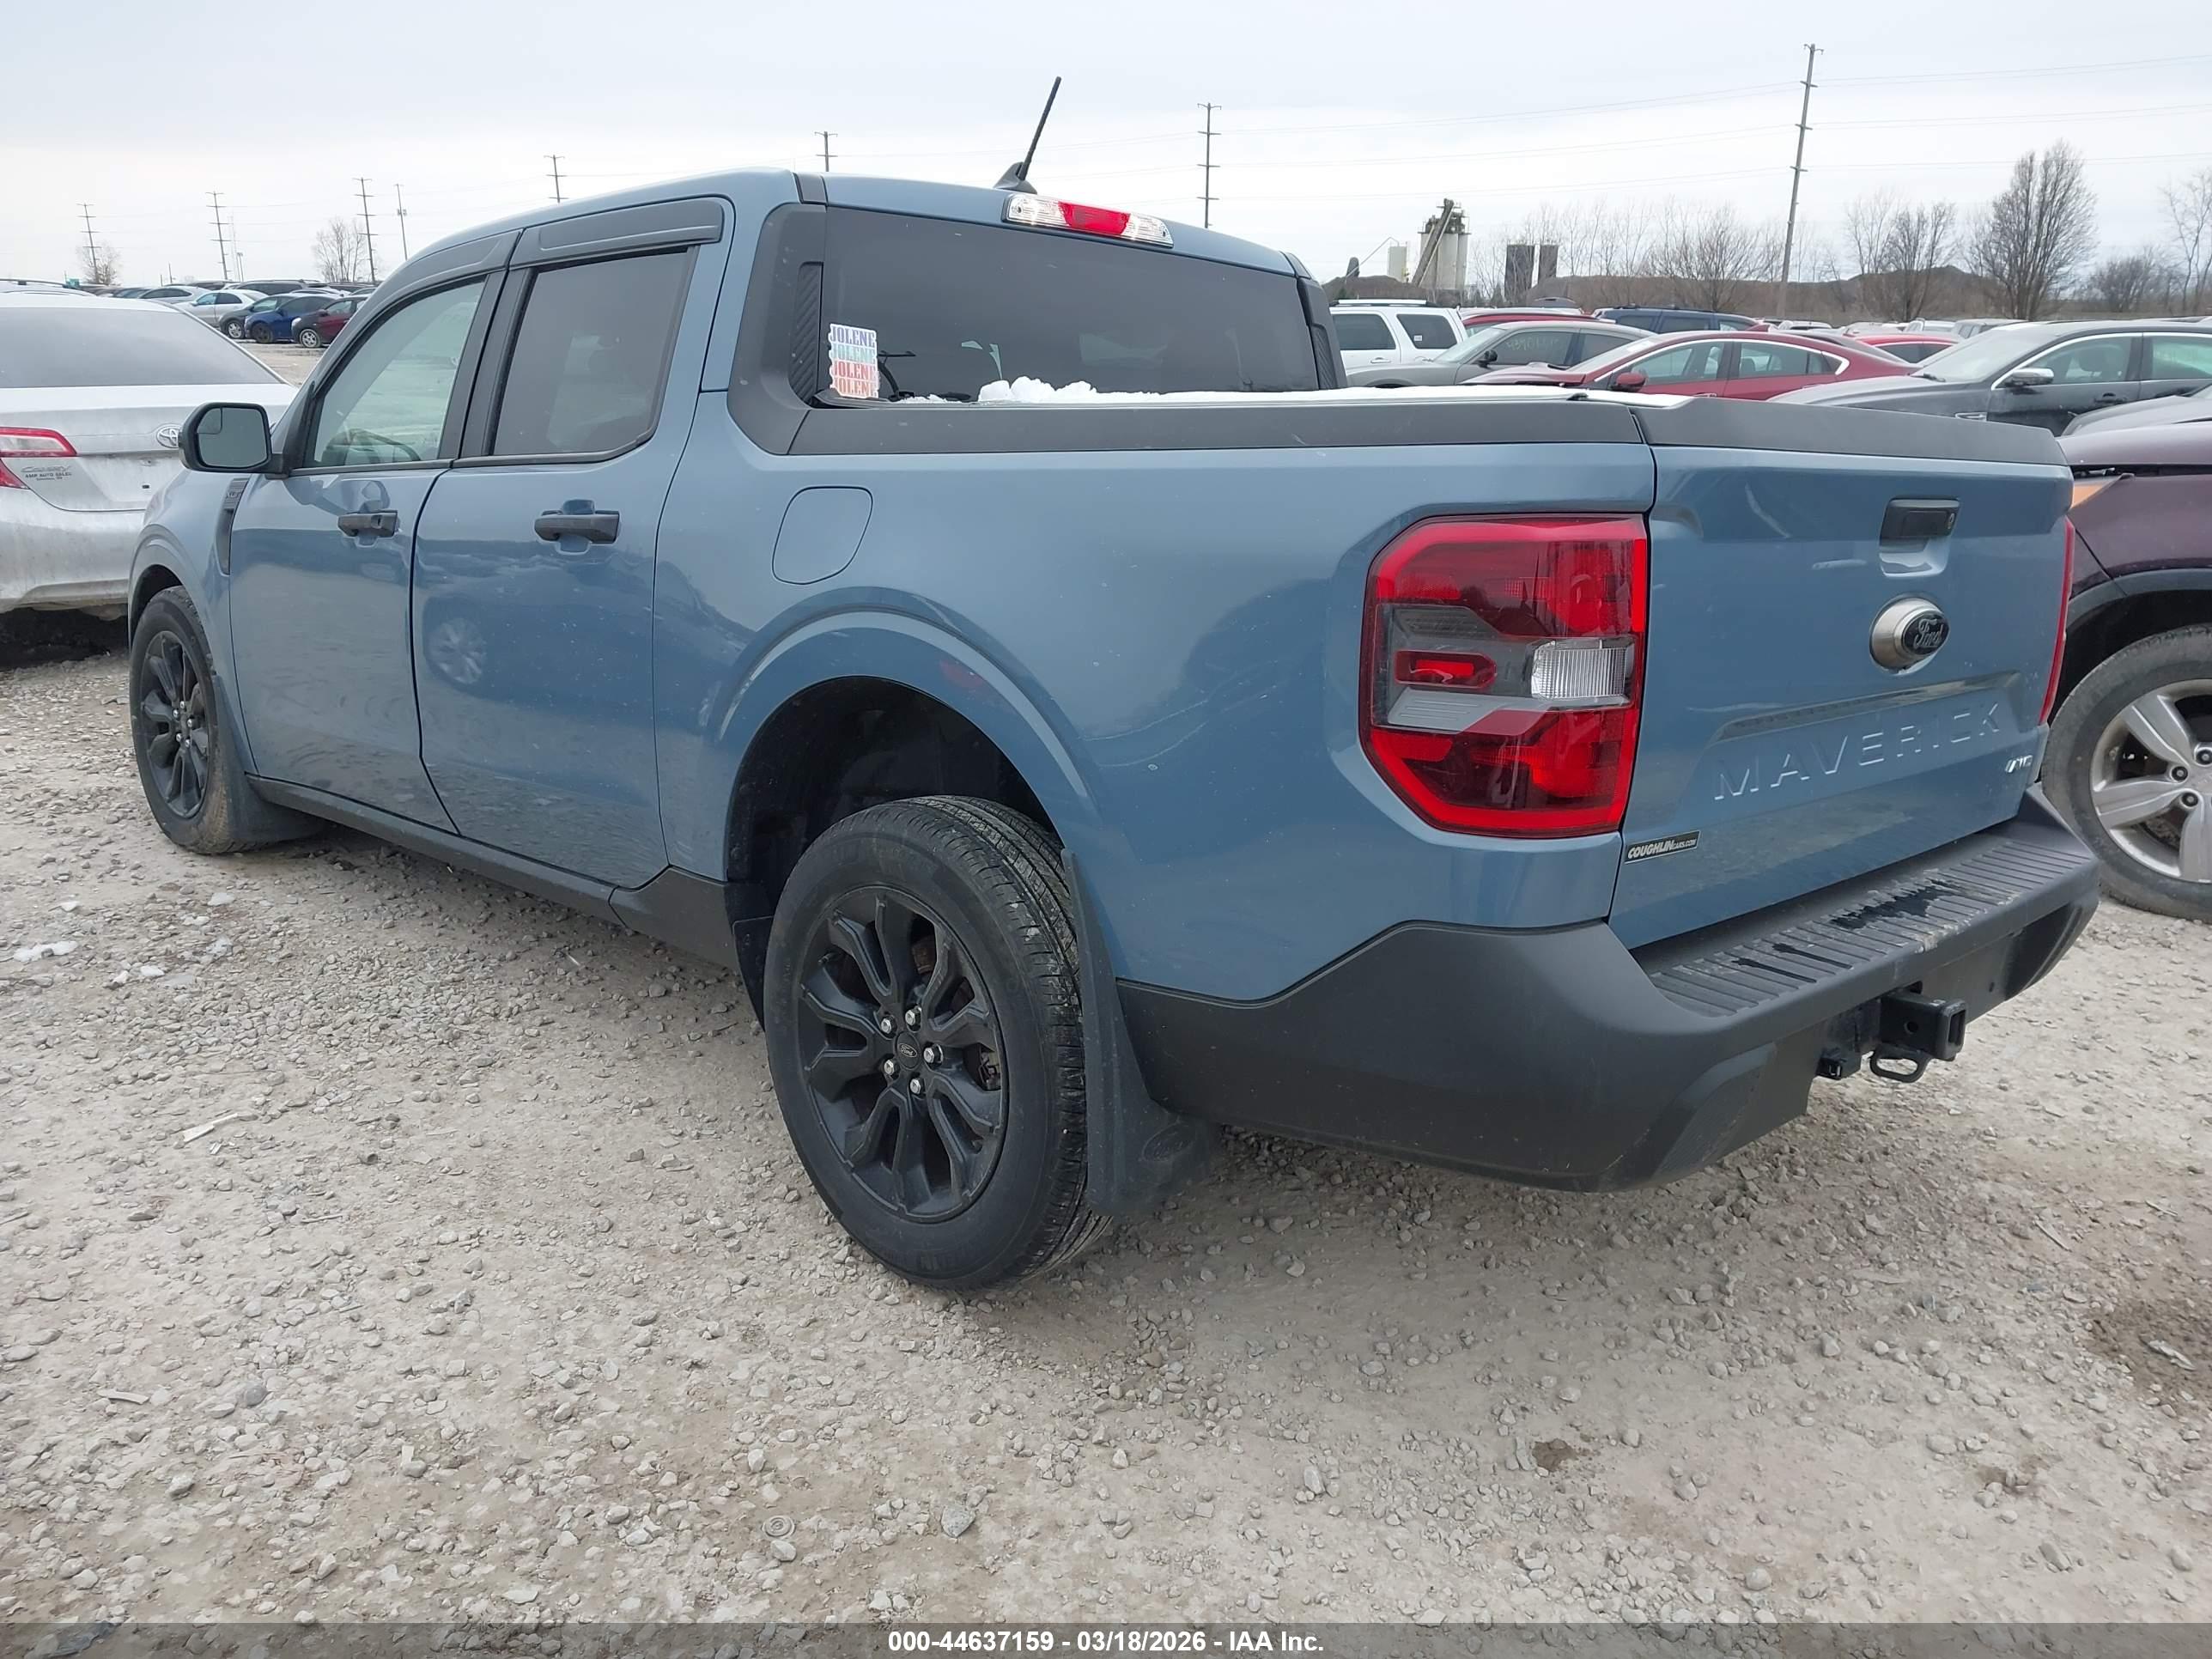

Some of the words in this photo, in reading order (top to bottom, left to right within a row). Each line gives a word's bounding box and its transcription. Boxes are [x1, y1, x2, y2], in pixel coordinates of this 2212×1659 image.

[830, 325, 876, 348] JOLENE
[830, 343, 876, 364] JOLENE
[831, 360, 877, 381] JOLENE
[1912, 617, 1944, 650] Ford
[1713, 701, 2001, 801] MAVERICK
